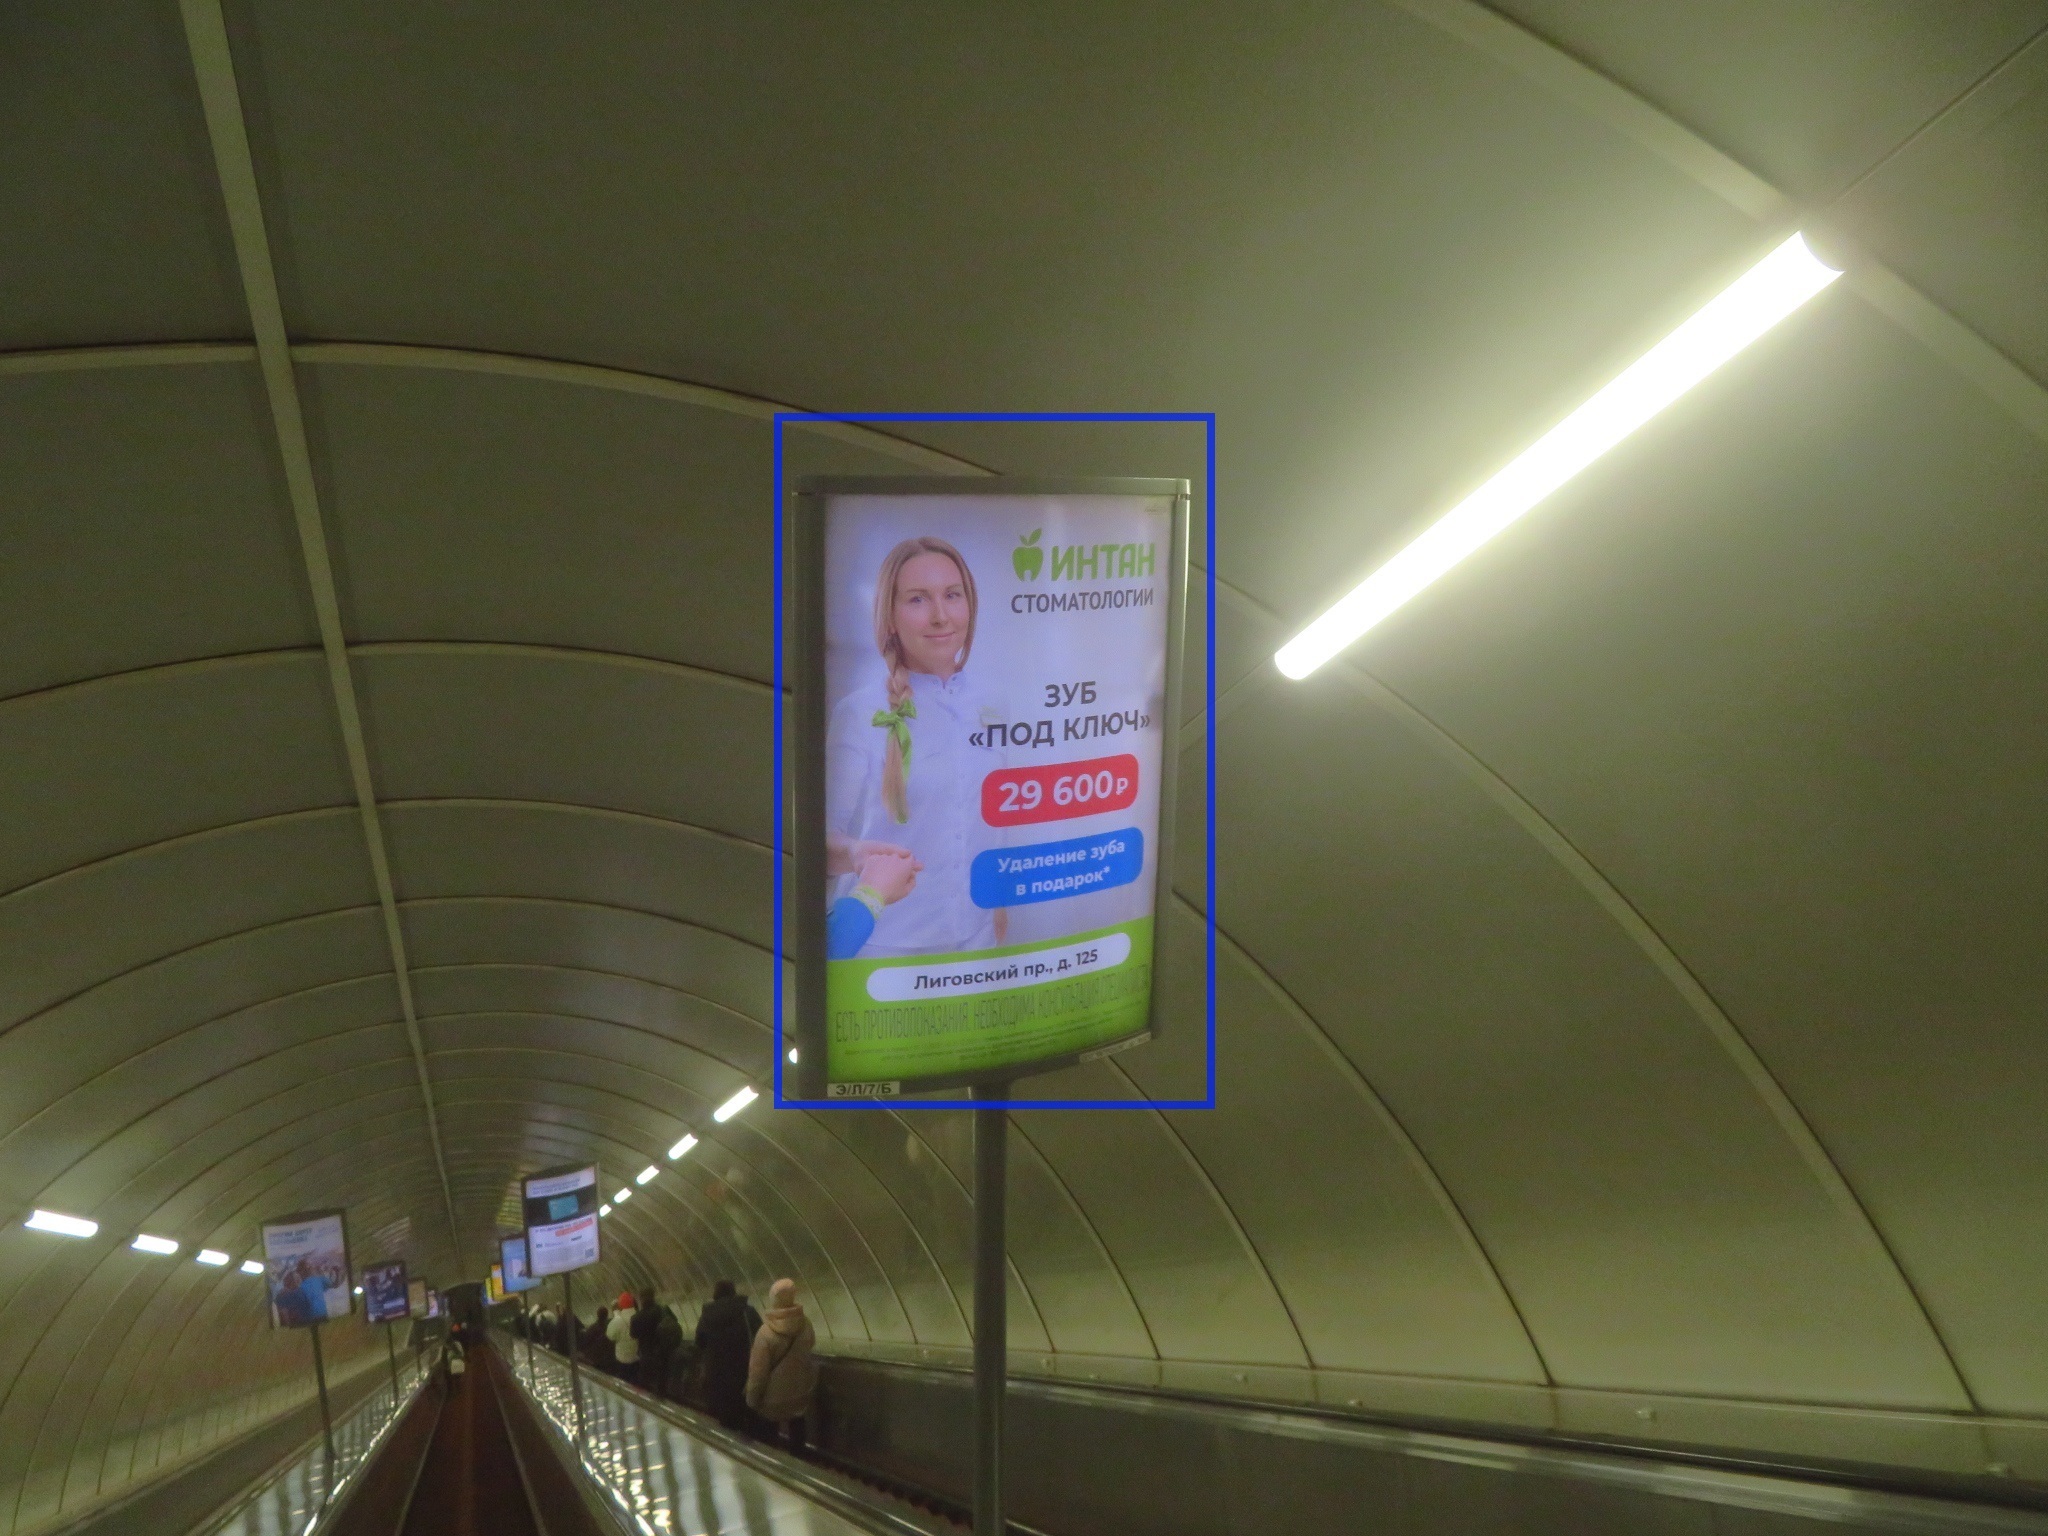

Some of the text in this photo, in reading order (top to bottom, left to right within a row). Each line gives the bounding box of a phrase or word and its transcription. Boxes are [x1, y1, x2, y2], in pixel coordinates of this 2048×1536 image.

[1051, 543, 1156, 581] ИНТАН
[1011, 588, 1154, 614] СТОМАТОЛОГИИ
[1044, 681, 1097, 708] ЗУБ
[968, 709, 1150, 748] «ПОД КЛЮЧ»
[998, 779, 1043, 812] 29
[998, 839, 1126, 873] Удаление зуба
[1015, 884, 1027, 896] в
[914, 964, 1019, 990] Лиговский
[1057, 957, 1072, 972] д.
[1075, 949, 1098, 966] 125
[836, 1011, 861, 1043] ЕСТЬ
[835, 1082, 892, 1096] Э/Л/7/Б
